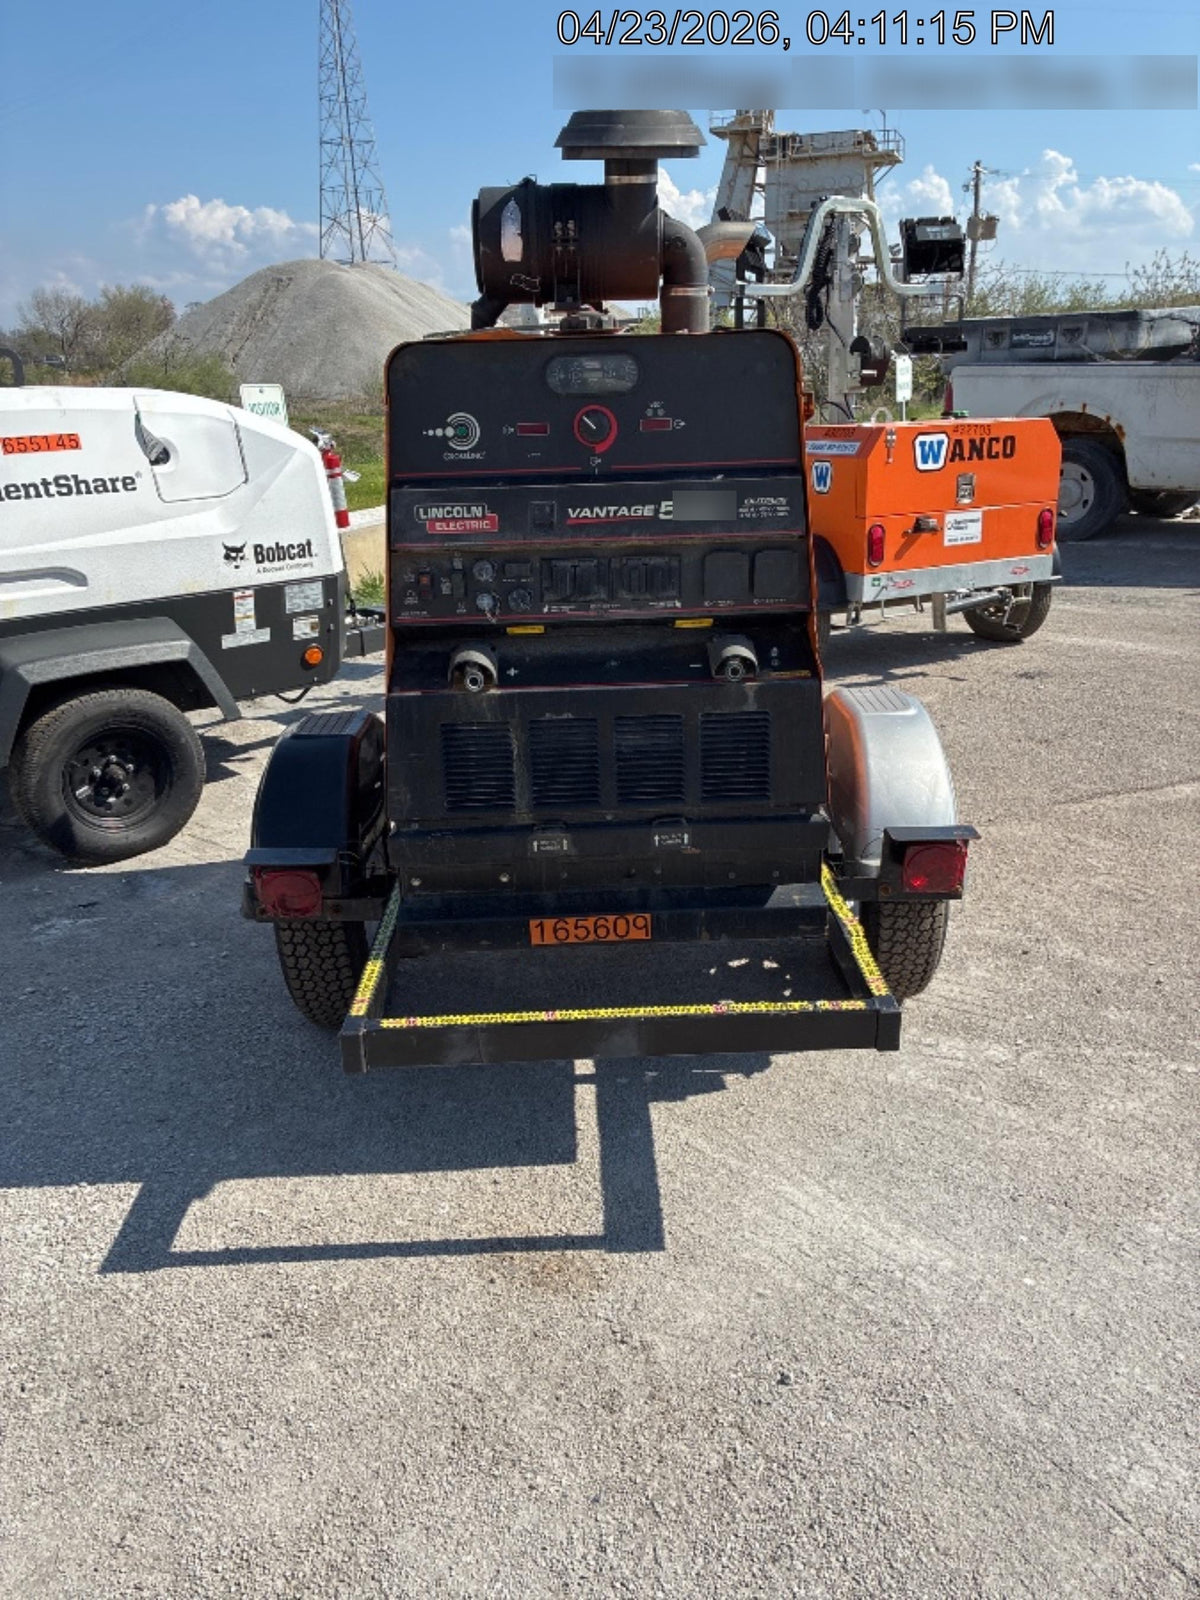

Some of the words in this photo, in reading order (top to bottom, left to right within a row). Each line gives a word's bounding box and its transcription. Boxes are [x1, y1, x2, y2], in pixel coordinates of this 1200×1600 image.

[919, 435, 1016, 465] WANCO
[813, 465, 830, 488] W
[419, 506, 483, 519] LINCOLN
[568, 505, 654, 519] VANTAGE
[435, 520, 491, 531] ELECTRIC
[254, 539, 313, 564] Bobcat
[535, 915, 649, 943] 165609
